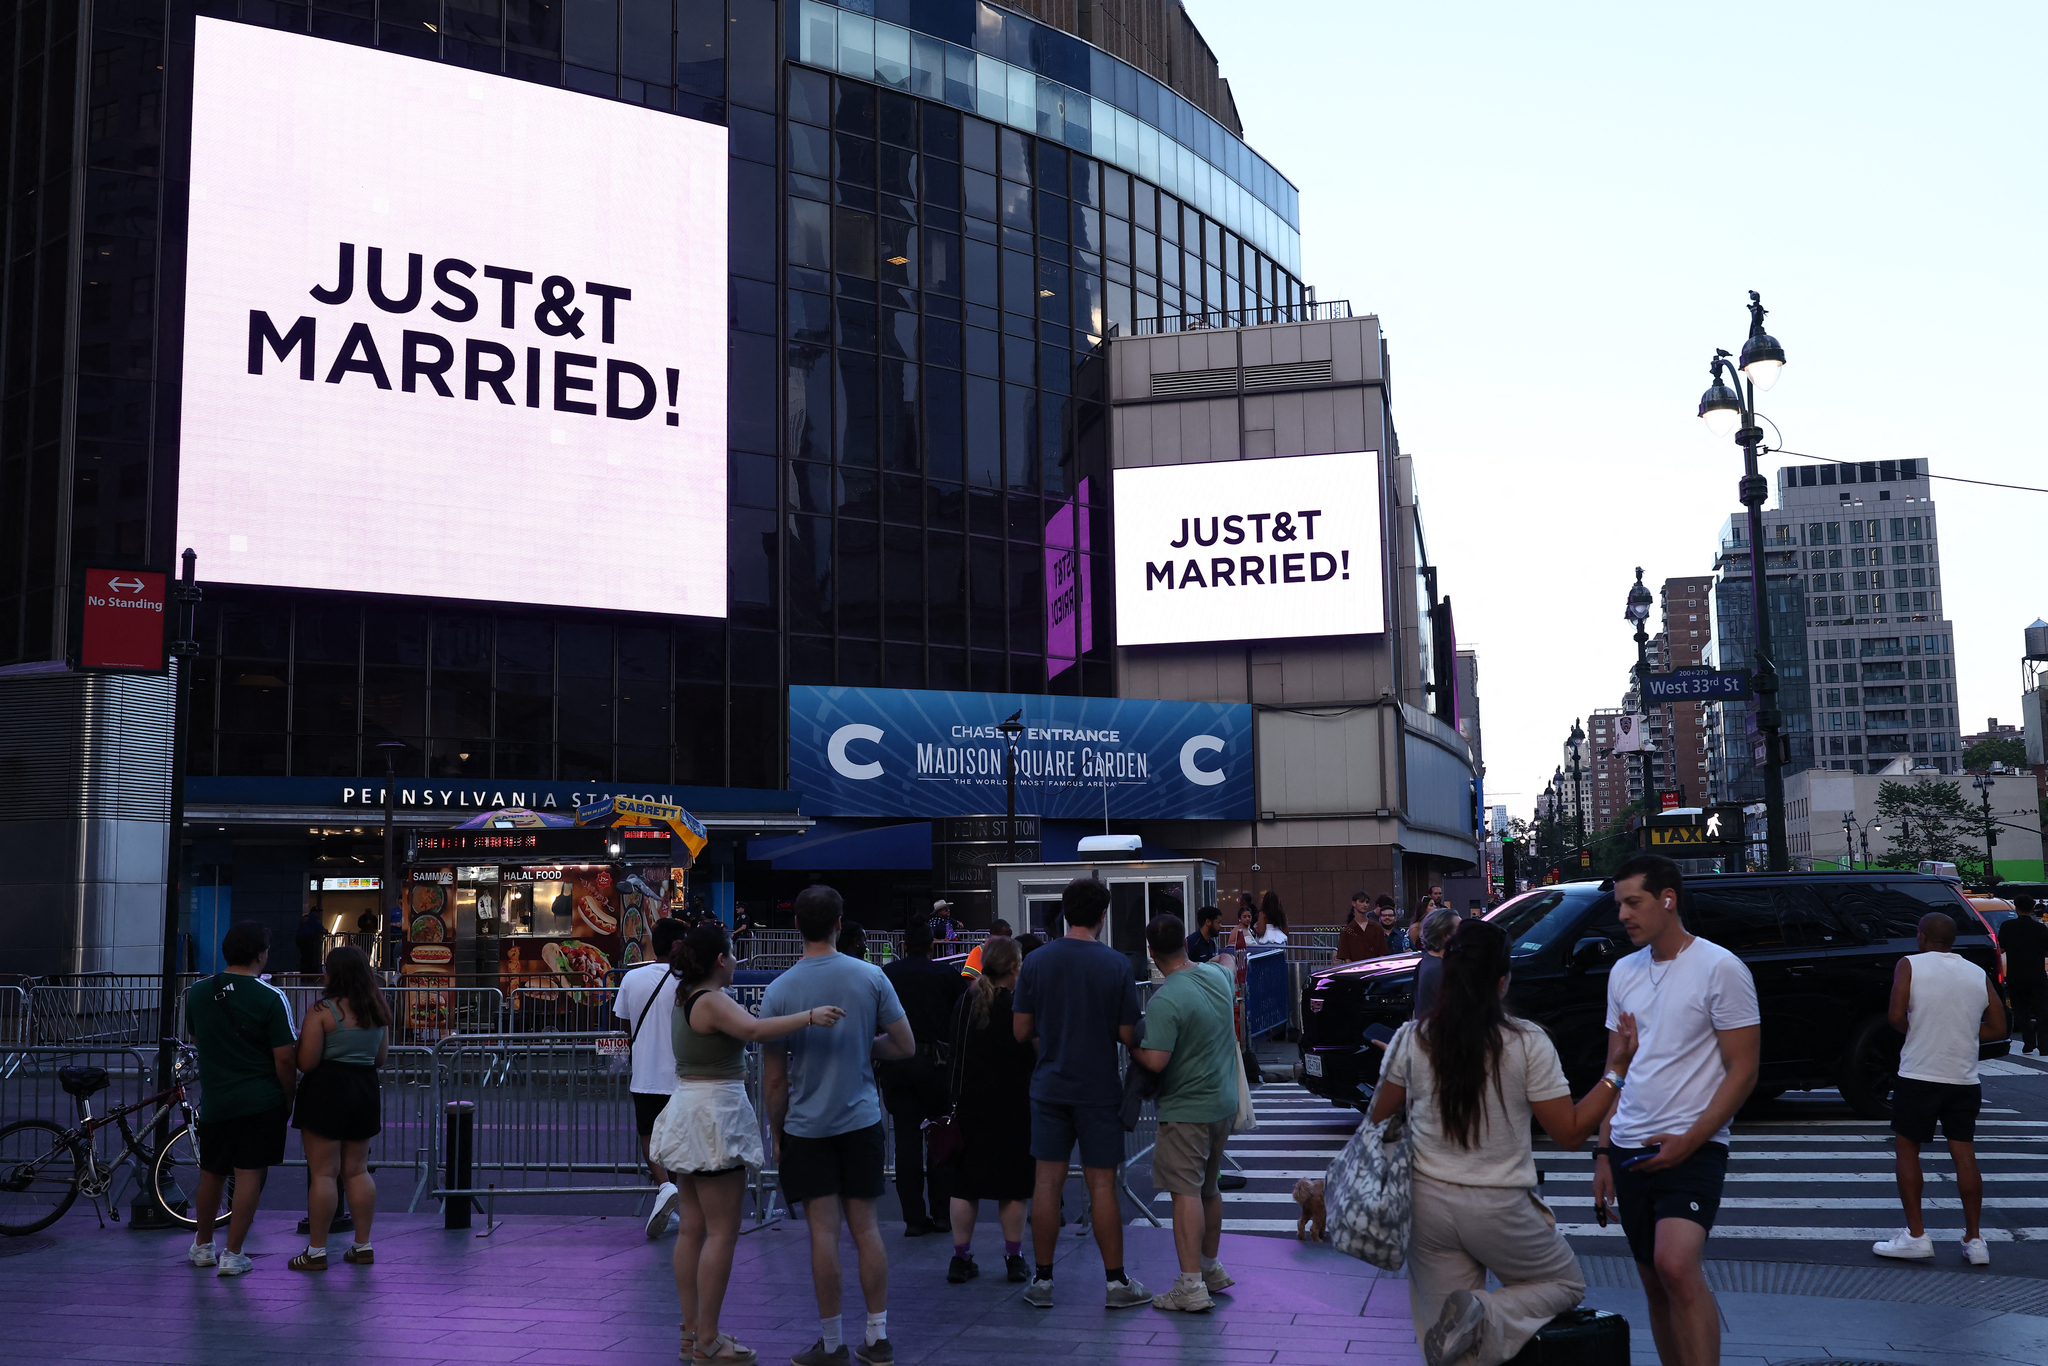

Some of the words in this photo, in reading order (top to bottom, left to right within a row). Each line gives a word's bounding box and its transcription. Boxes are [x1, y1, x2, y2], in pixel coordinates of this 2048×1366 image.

[309, 242, 632, 345] JUST&T
[247, 309, 681, 427] MARRIED!
[1171, 509, 1323, 549] JUST&T
[1146, 551, 1351, 591] MARRIED!
[88, 595, 106, 607] No
[107, 597, 163, 612] Standing
[1650, 680, 1688, 695] West
[1692, 677, 1719, 693] 33rd
[1723, 677, 1740, 692] St
[951, 725, 1005, 739] CHASE
[1028, 728, 1120, 743] ENTRANCE
[917, 742, 1001, 776] MADISON
[1010, 745, 1076, 778] SQUARE
[975, 778, 1016, 786] WORLD
[1048, 780, 1084, 788] FAMOUS
[618, 800, 678, 819] SABRETT
[992, 820, 1035, 836] STTION
[1655, 828, 1701, 843] TAX
[413, 871, 453, 882] SAMMY'S
[503, 871, 533, 881] HALAL
[535, 869, 562, 880] FOOD
